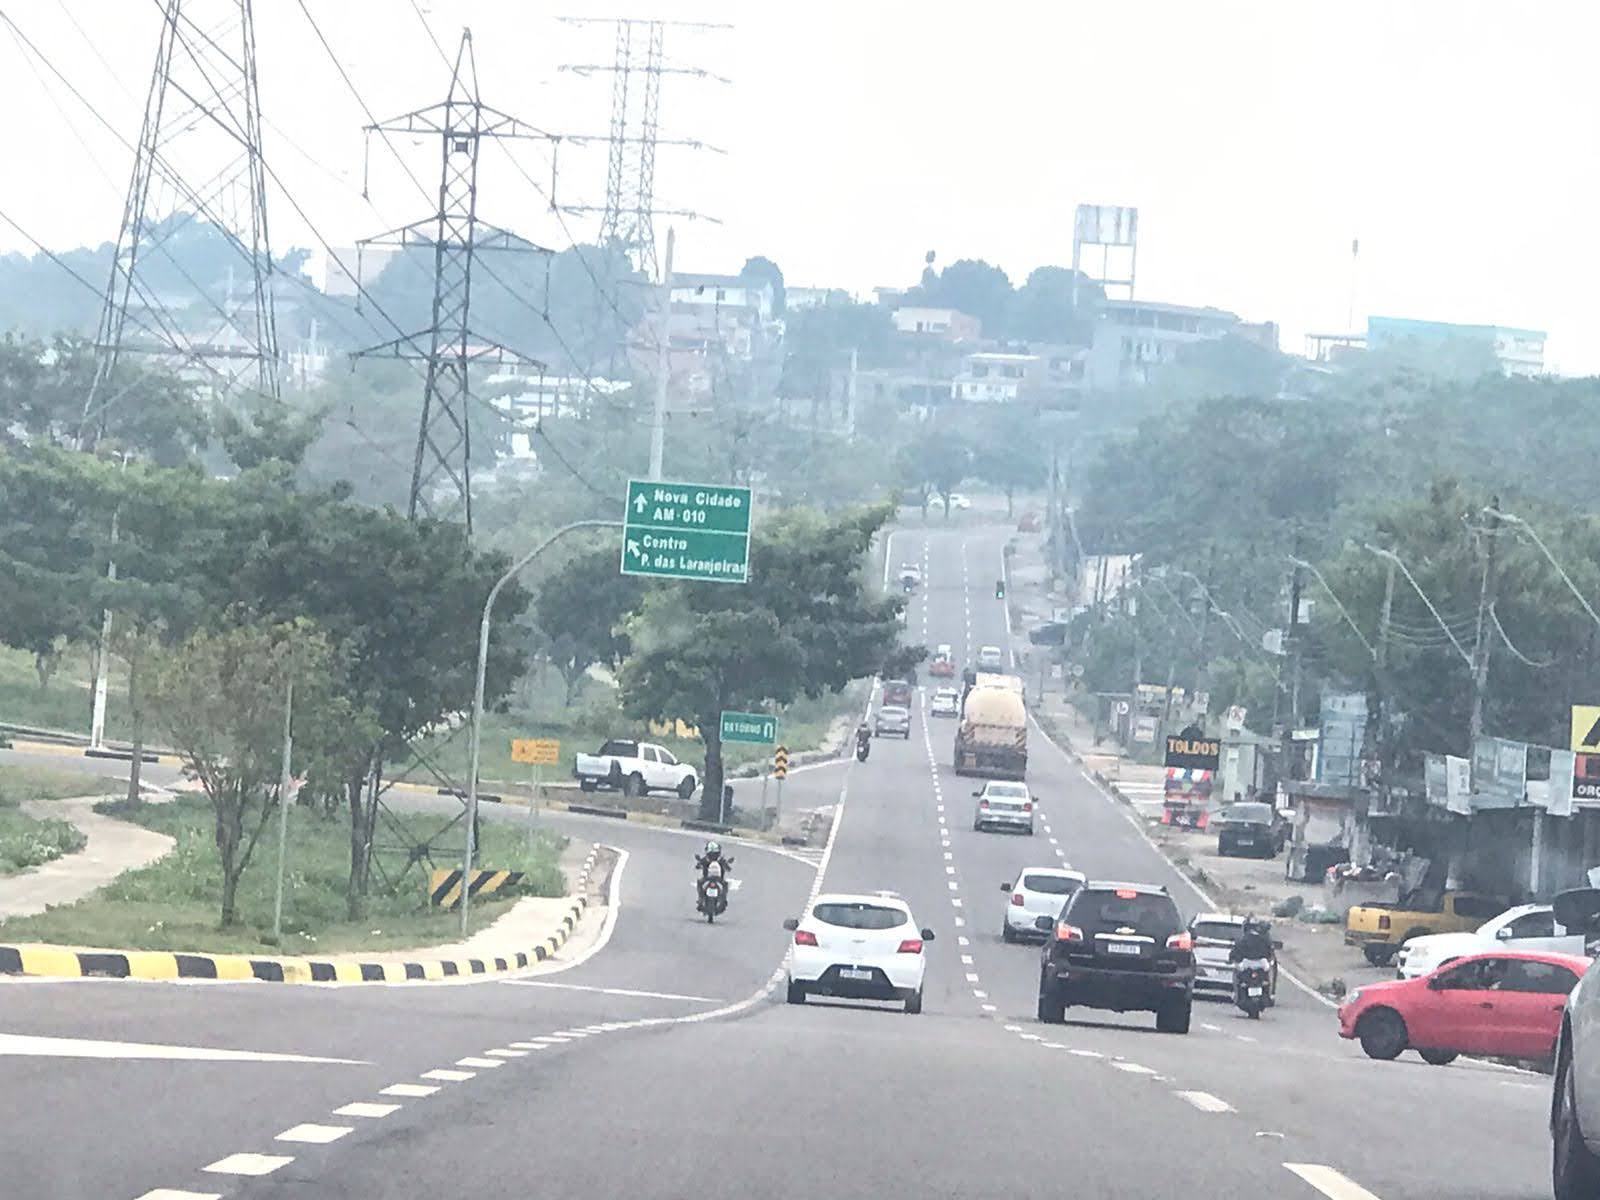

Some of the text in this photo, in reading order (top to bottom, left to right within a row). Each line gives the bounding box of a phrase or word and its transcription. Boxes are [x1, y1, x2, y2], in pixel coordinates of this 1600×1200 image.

[654, 488, 742, 508] Nova Cidade
[643, 534, 688, 550] Centro
[641, 552, 746, 576] P. das Laranjeiras
[1167, 738, 1219, 757] TOLDOS
